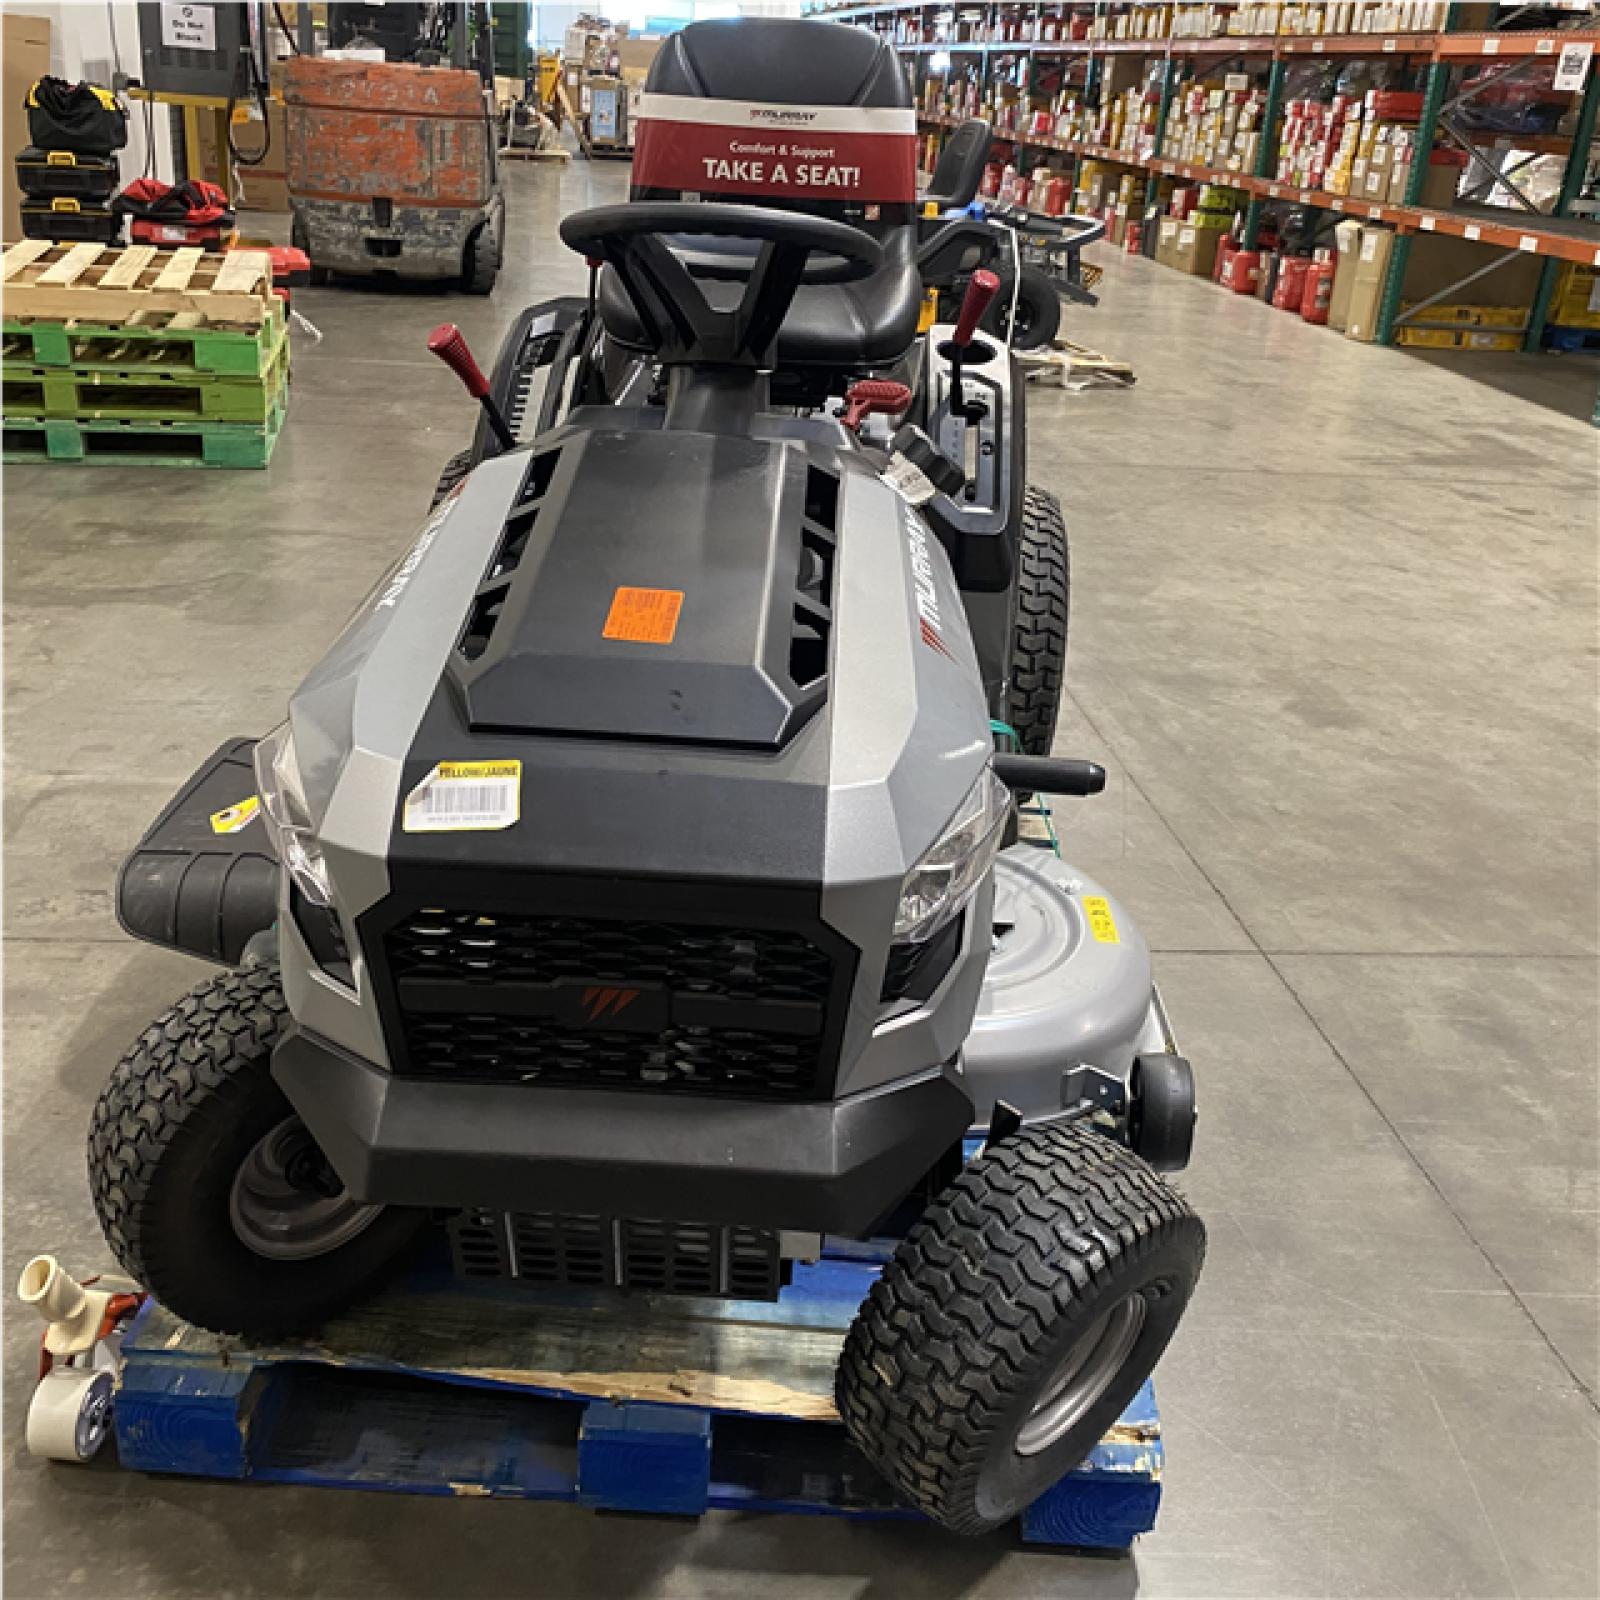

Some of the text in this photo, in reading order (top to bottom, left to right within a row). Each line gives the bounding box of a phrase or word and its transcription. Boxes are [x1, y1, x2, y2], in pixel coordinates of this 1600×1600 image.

[729, 141, 836, 161] Comfort & Support
[702, 157, 861, 188] TAKE A SEAT!
